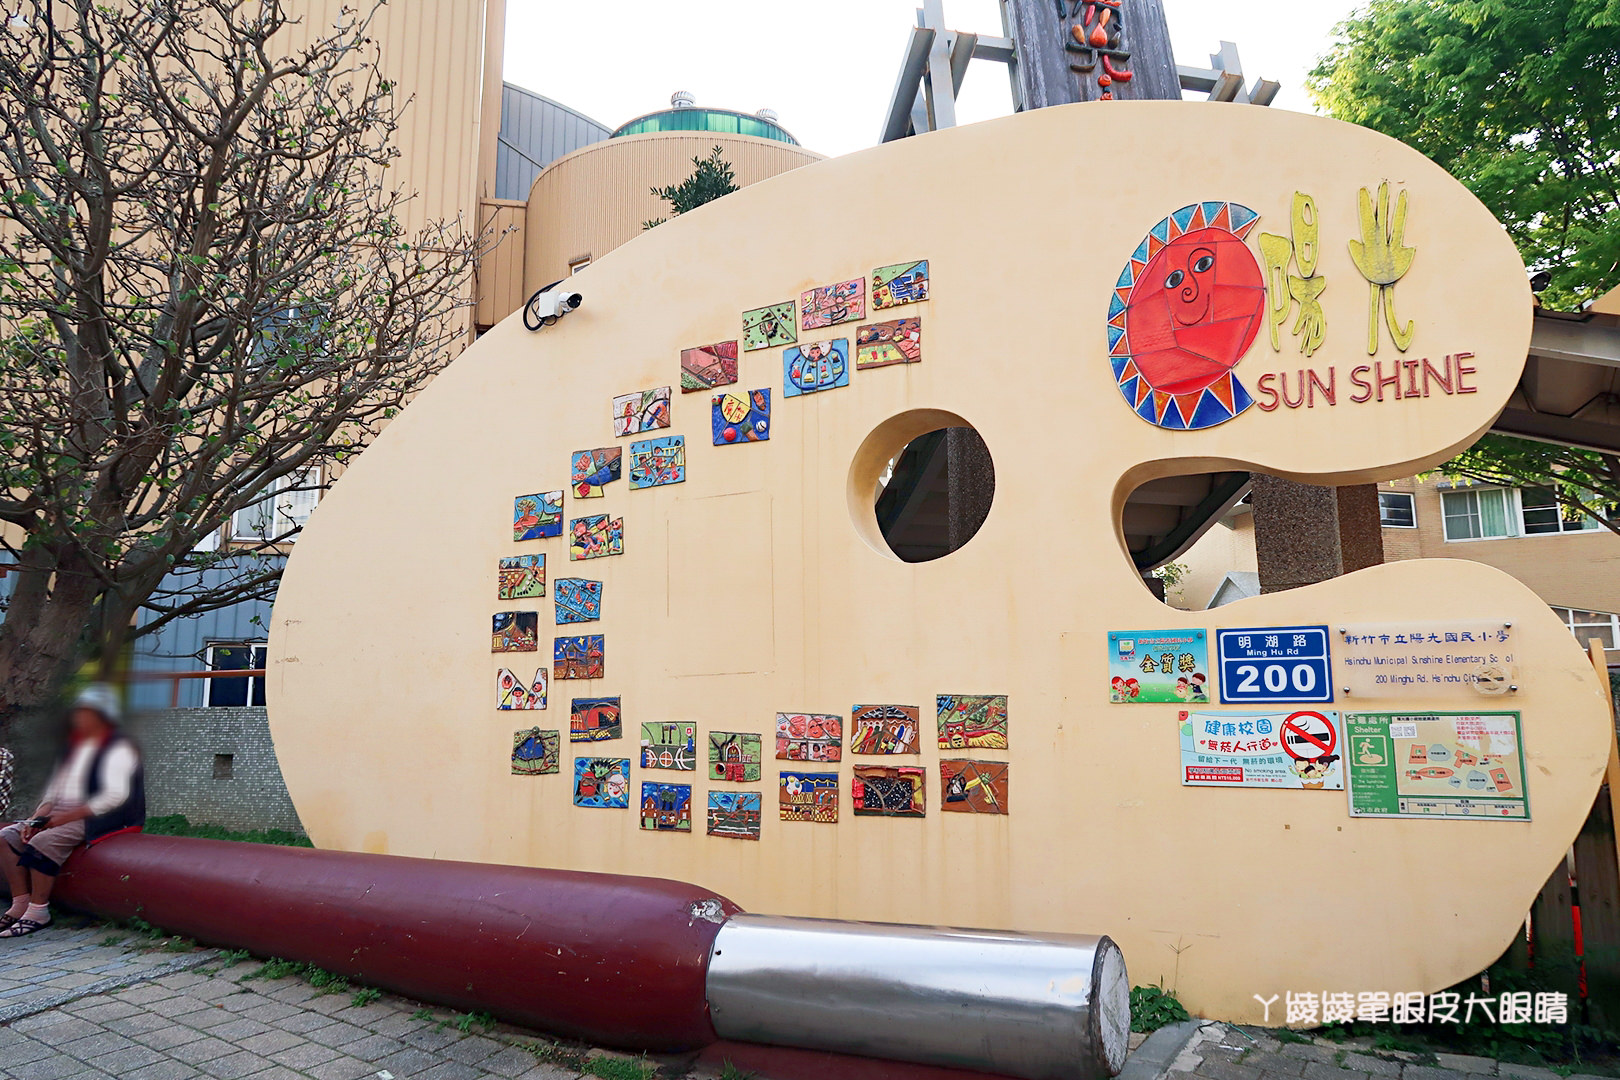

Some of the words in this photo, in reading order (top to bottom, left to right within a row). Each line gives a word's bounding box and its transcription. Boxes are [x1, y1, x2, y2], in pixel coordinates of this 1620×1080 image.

[1258, 181, 1416, 358] 陽光
[1257, 366, 1337, 412] SUN
[1349, 352, 1478, 404] SHINE
[1238, 634, 1307, 649] 明湖路
[1344, 631, 1510, 645] 新竹市立陽光國民小學
[1246, 649, 1267, 657] Ming
[1344, 656, 1372, 666] Hsinchu
[1445, 654, 1486, 665] Elementary
[1489, 653, 1514, 663] Scol
[1139, 653, 1196, 674] 金質獎
[1236, 664, 1316, 693] 200
[1375, 674, 1388, 684] 200
[1204, 718, 1273, 736] 健康校園
[1207, 738, 1271, 753] 無菸人行道
[1197, 755, 1238, 765] 留給下一代
